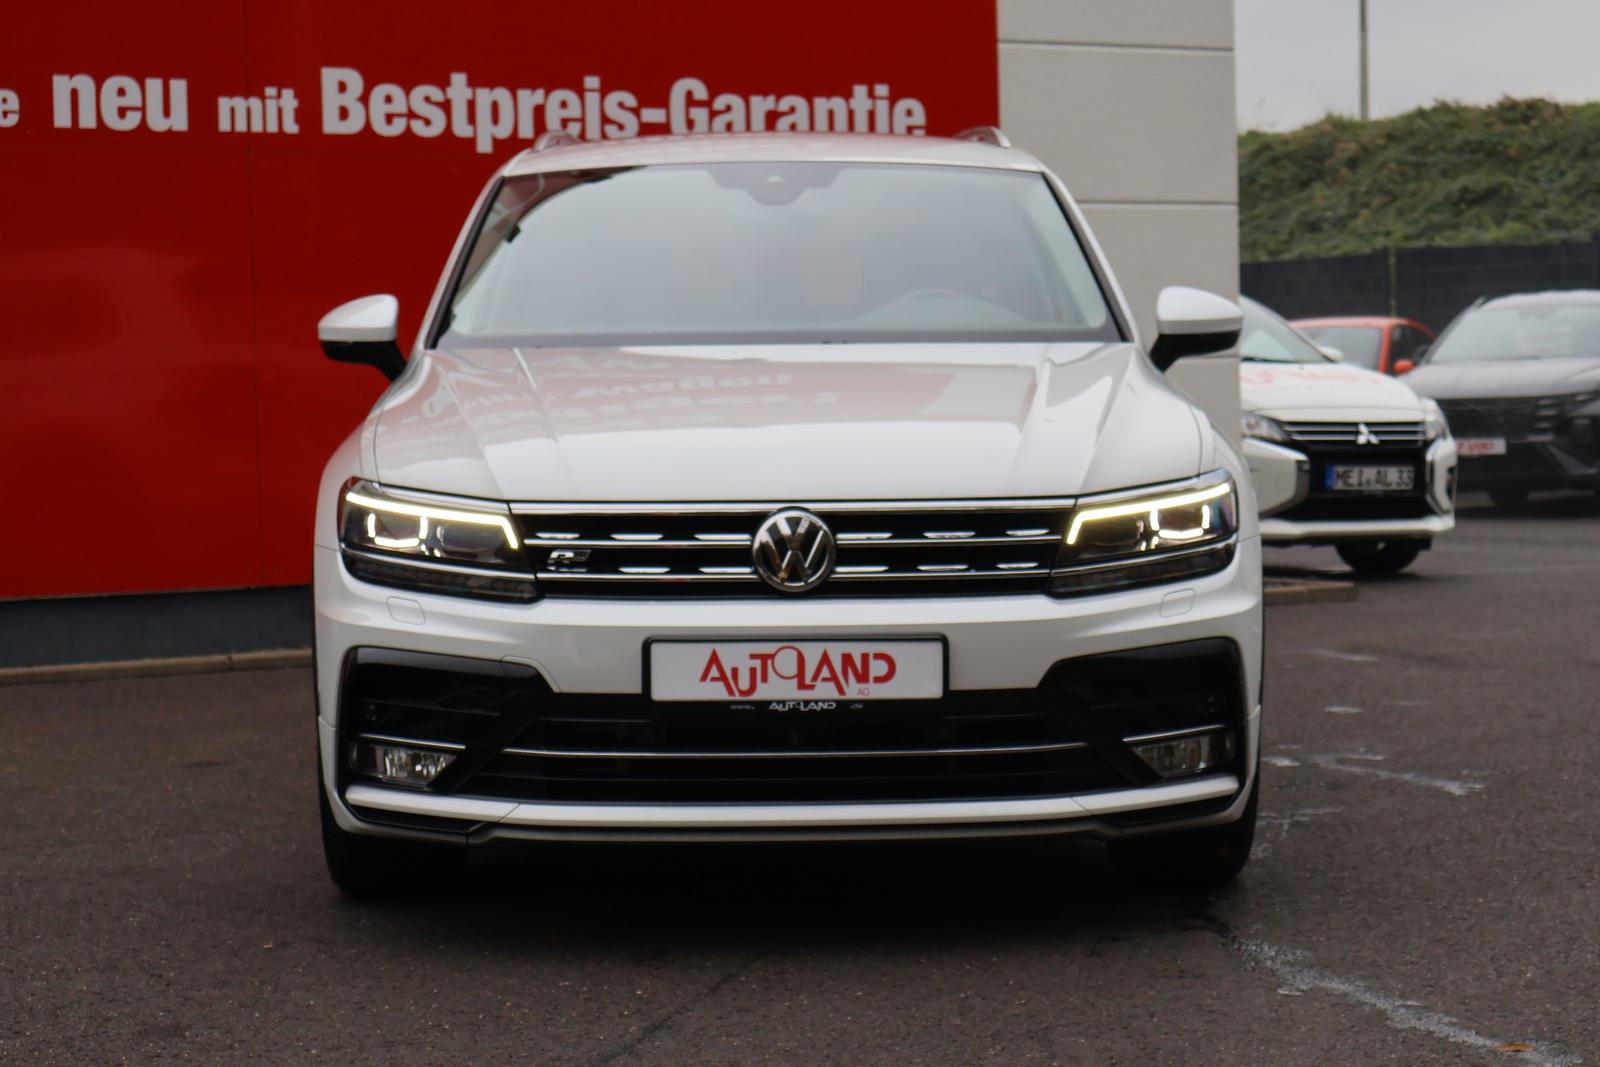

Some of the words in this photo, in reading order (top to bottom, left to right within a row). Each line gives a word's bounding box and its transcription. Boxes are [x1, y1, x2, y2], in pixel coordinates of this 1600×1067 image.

[52, 73, 189, 132] neu
[217, 87, 299, 134] mit
[320, 66, 926, 153] Bestpreis-Garantie
